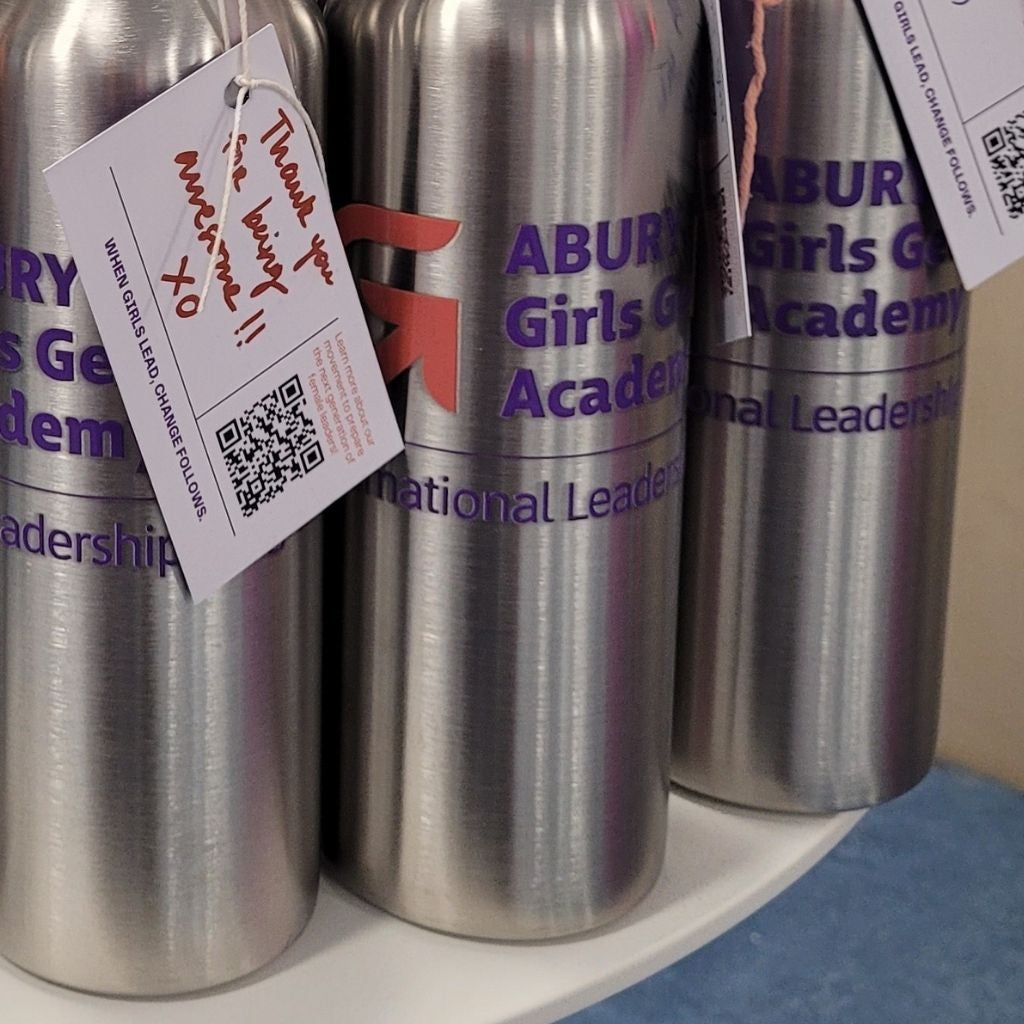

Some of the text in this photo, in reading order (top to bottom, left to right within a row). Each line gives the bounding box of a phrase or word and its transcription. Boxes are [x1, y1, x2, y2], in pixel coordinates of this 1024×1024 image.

[893, 0, 917, 46] GIRLS
[909, 45, 930, 88] LEAD,
[924, 87, 951, 148] CHANGE
[945, 147, 978, 219] FOLLOWS.
[749, 157, 923, 207] ABUR
[742, 220, 878, 274] Girls
[505, 289, 643, 348] Girls
[748, 285, 964, 338] Academy
[104, 237, 208, 522] WHEN GIRLS LEAD, CHANGE FOLLOWS.
[312, 347, 323, 367] the
[335, 331, 349, 365] Learn
[345, 365, 358, 395] more
[354, 395, 369, 428] about
[323, 339, 347, 401] movement
[346, 413, 365, 457] prepare
